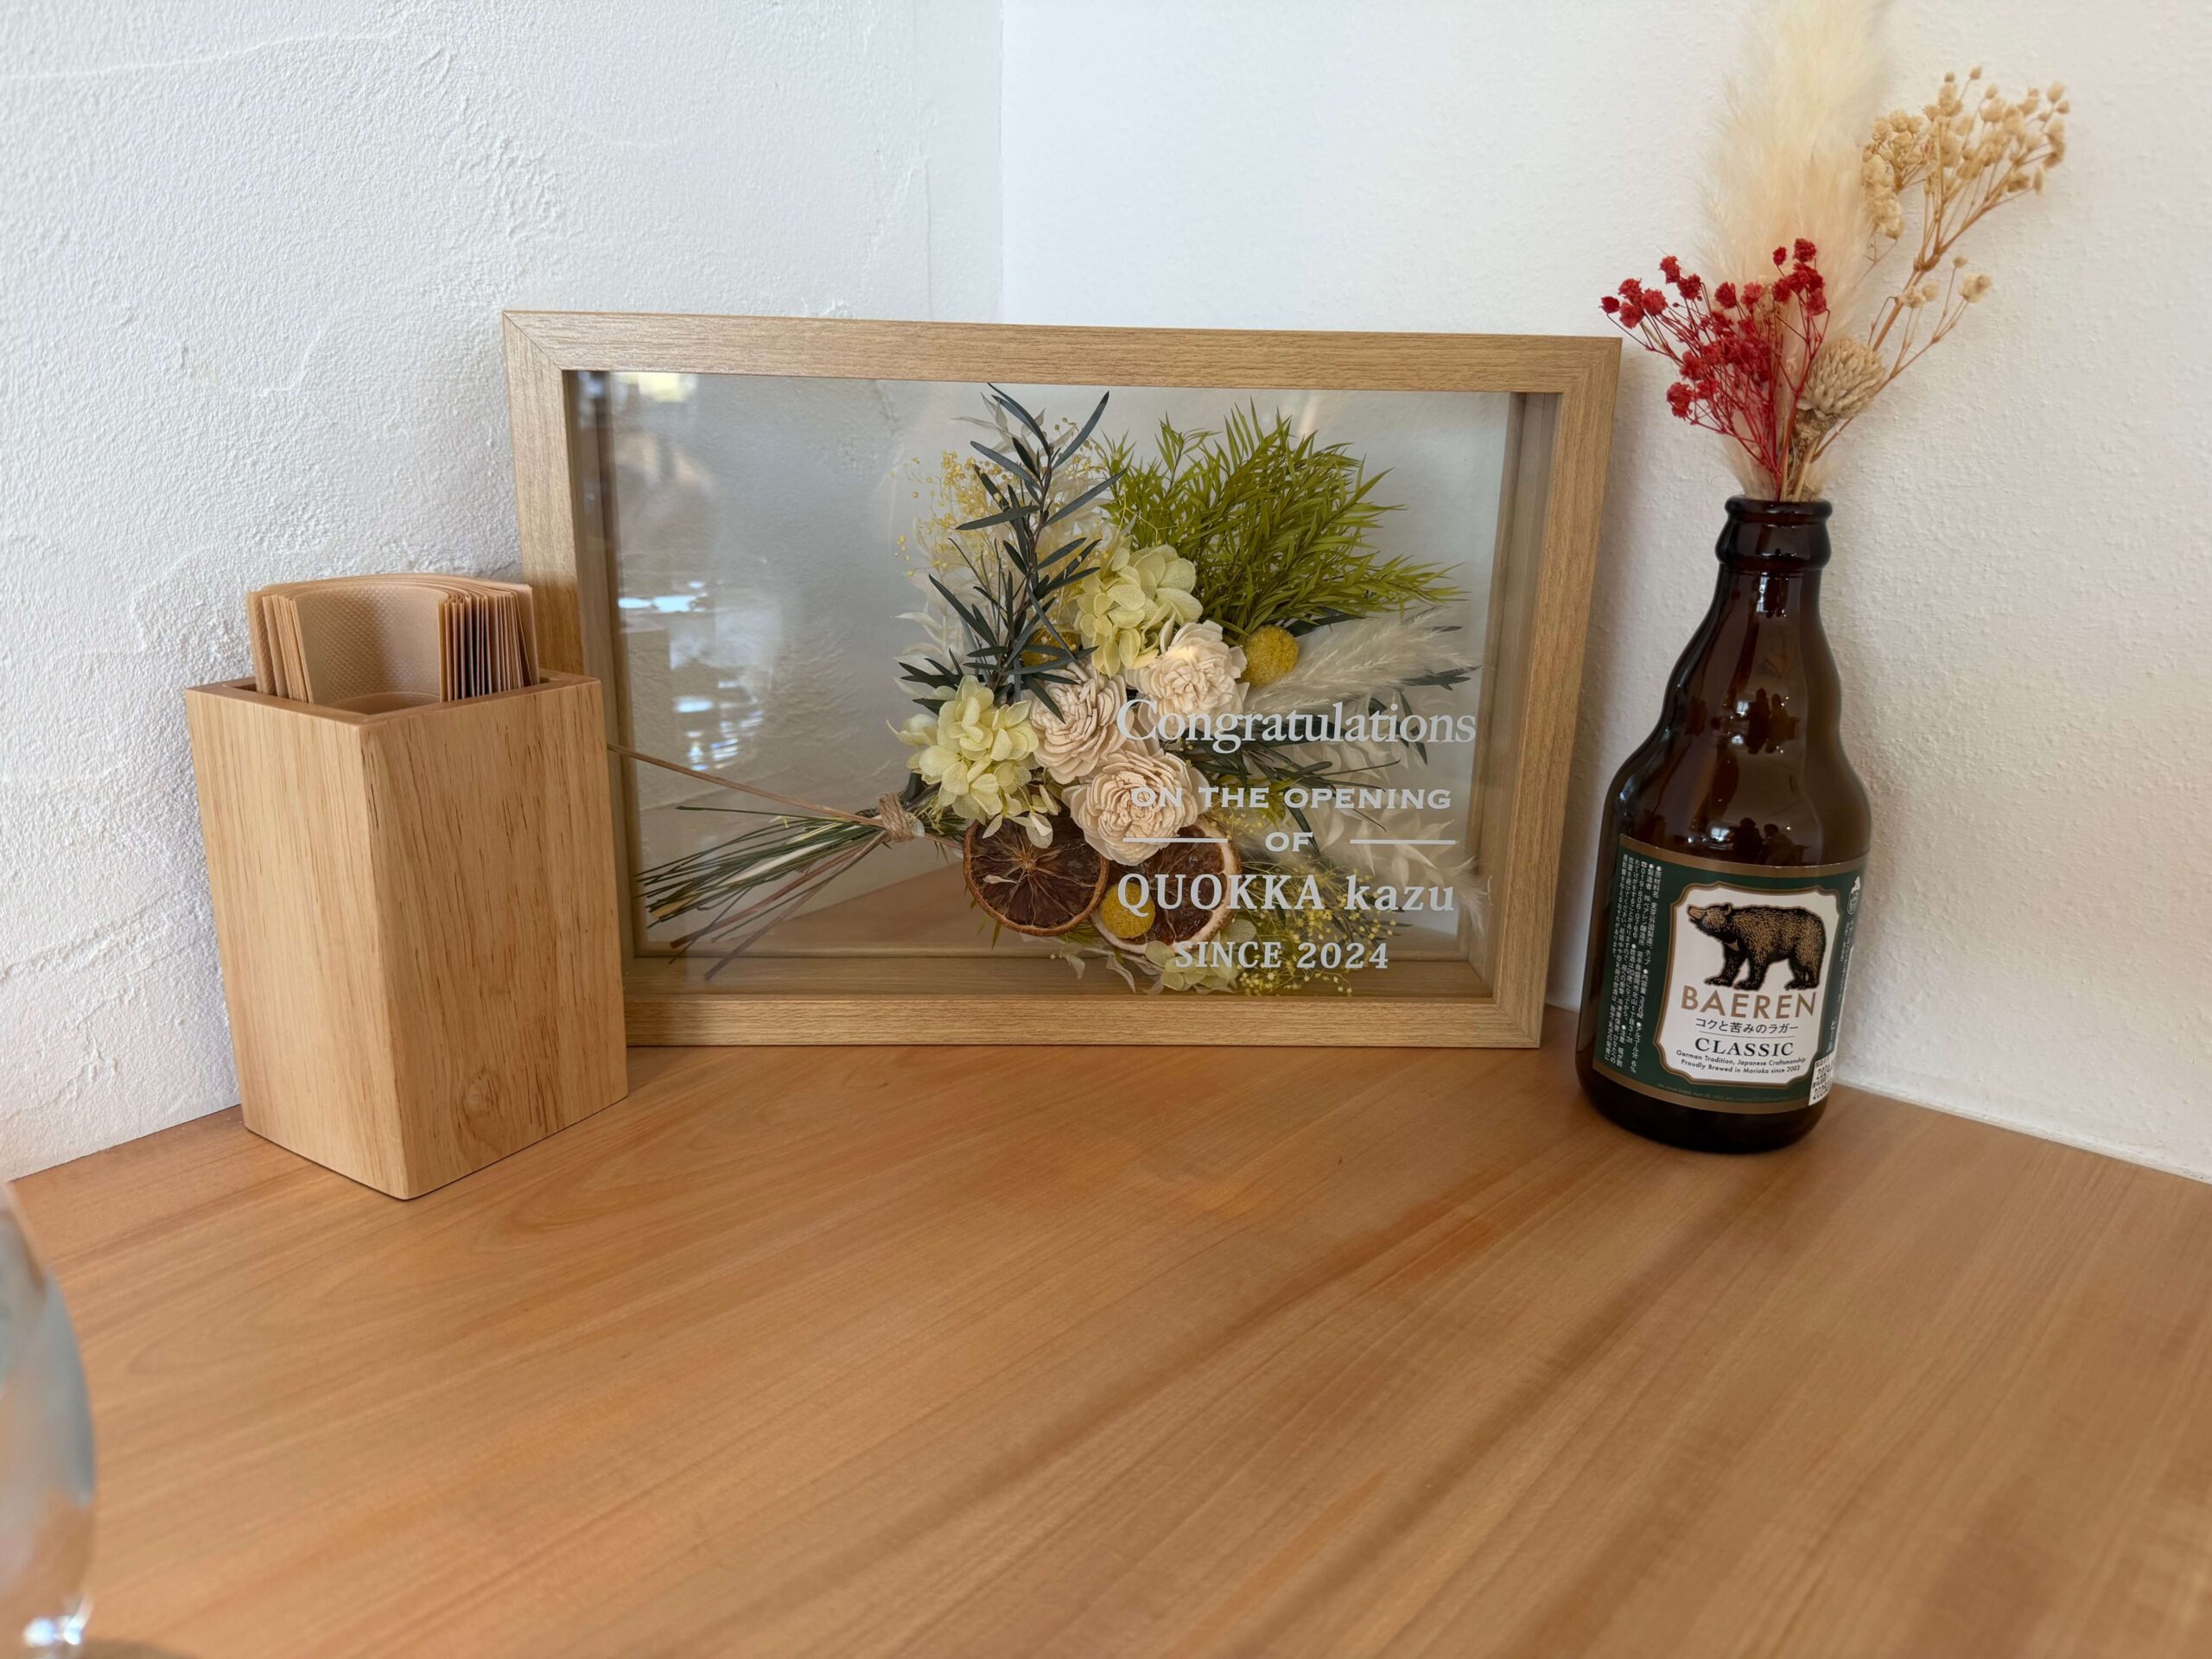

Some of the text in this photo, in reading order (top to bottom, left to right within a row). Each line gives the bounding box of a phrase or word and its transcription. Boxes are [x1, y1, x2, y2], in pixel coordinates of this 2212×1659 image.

[1116, 699, 1477, 753] Congratulations
[1131, 786, 1452, 810] ON THE OPENING
[1265, 831, 1313, 852] OF
[1117, 873, 1455, 917] QUOKKA kazu
[1175, 941, 1389, 969] SINCE 2024
[1681, 985, 1816, 1019] BAEREN
[1695, 1018, 1798, 1034] コクと苦みのラガー
[1676, 1049, 1702, 1060] German
[1705, 1055, 1735, 1065] Tradition,
[1737, 1059, 1767, 1068] Japanese
[1769, 1057, 1806, 1066] Craftsmanship
[1694, 1038, 1794, 1057] CLASSIC
[1681, 1058, 1706, 1070] Proudly
[1708, 1064, 1733, 1072] Brewed
